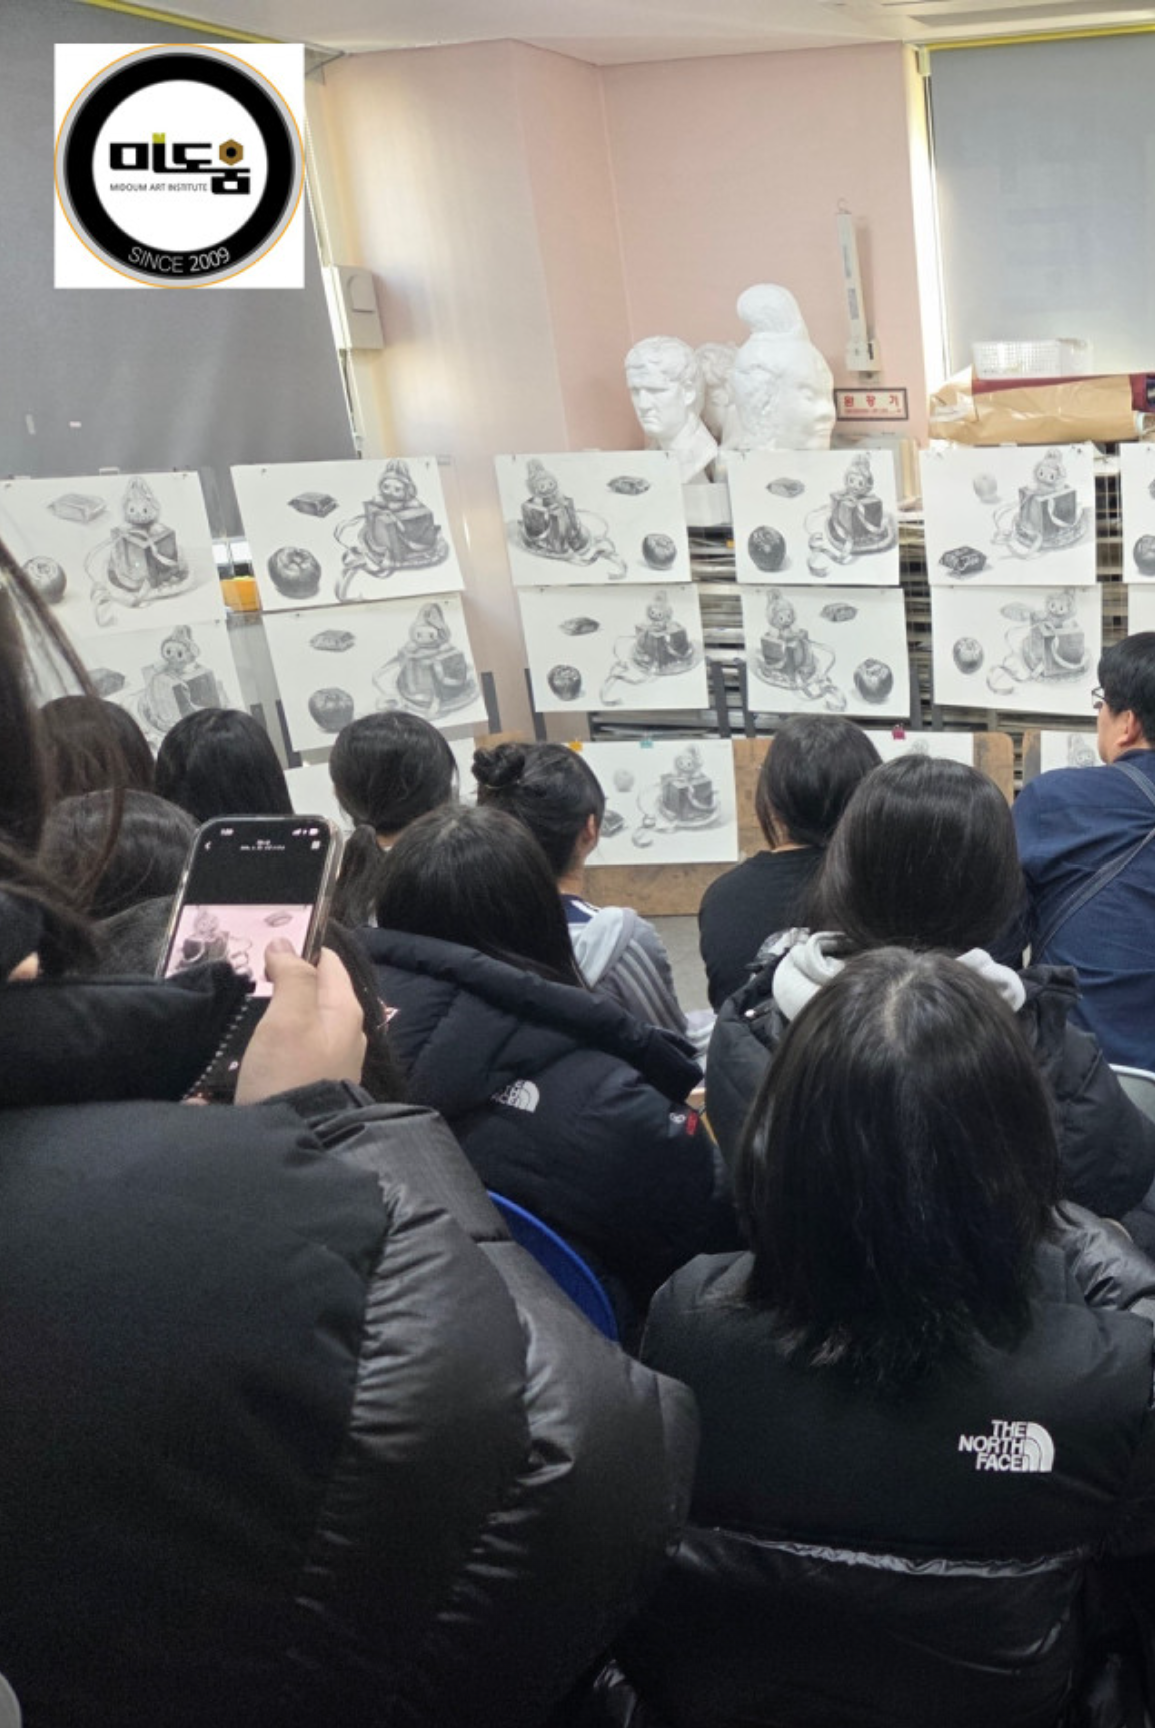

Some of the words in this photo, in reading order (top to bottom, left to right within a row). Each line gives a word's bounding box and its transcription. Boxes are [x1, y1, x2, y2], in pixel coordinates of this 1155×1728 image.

[990, 1419, 1028, 1438] THE
[958, 1434, 1024, 1455] NORTH
[975, 1452, 1022, 1472] FACE
